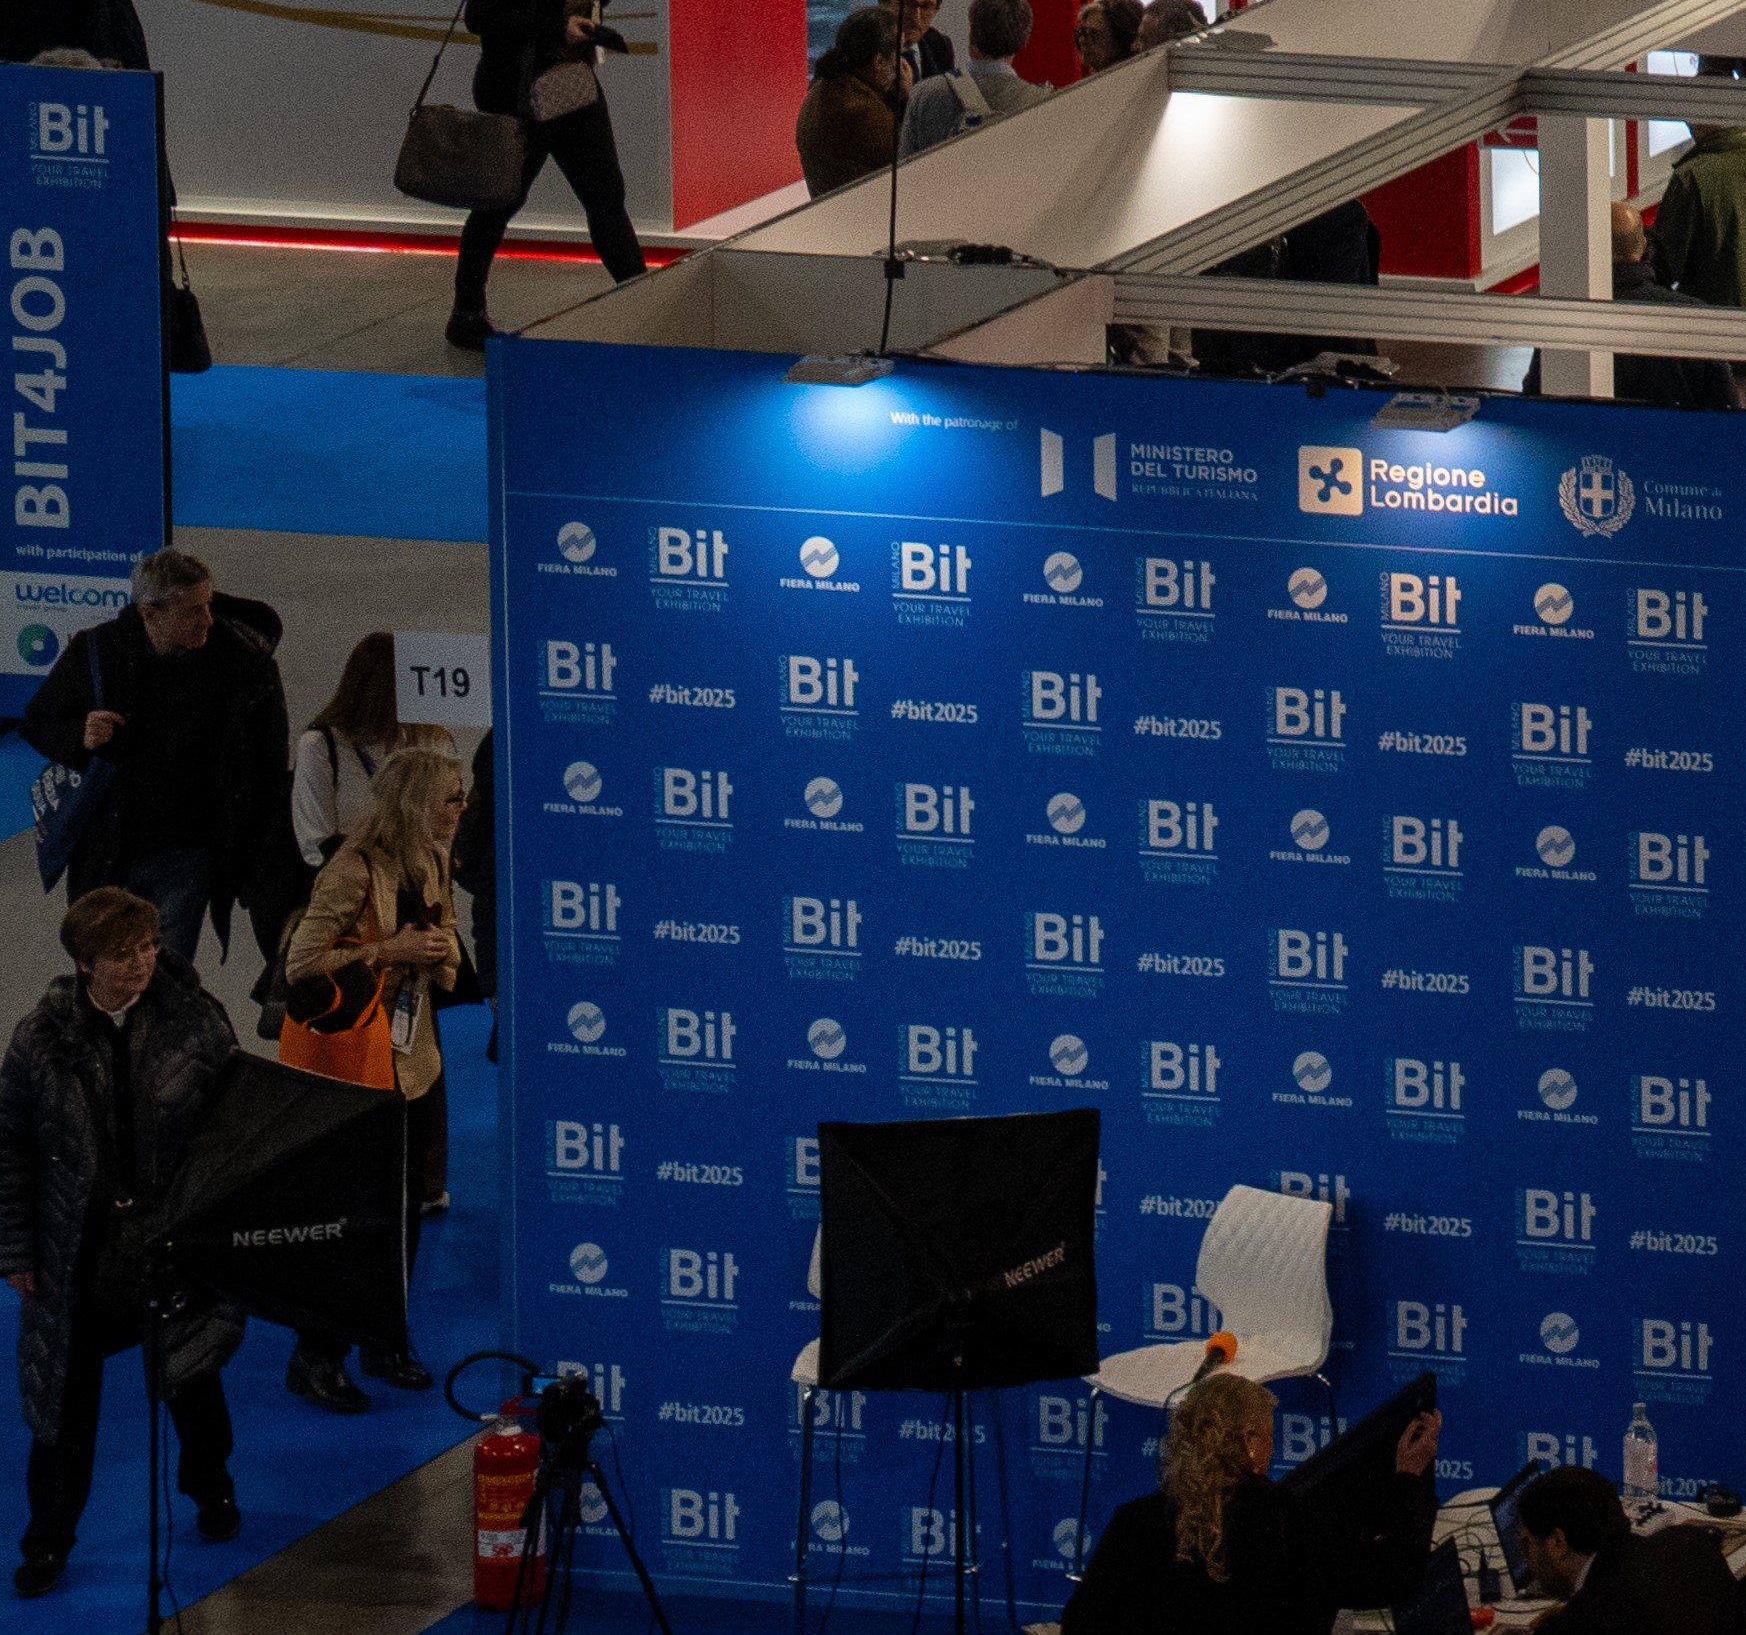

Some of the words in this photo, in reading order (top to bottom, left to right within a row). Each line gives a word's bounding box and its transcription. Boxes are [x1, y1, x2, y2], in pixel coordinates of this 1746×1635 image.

[39, 102, 110, 155] Bit
[11, 225, 70, 530] BIT4JOB
[891, 411, 920, 427] With
[923, 413, 941, 427] the
[943, 415, 1004, 434] patronage
[1006, 418, 1019, 431] of
[1131, 443, 1234, 465] MINISTERO
[1131, 461, 1167, 478] DEL
[1172, 463, 1258, 485] TURISMO
[1370, 458, 1486, 491] Regione
[1370, 484, 1518, 516] Lombardia
[1644, 481, 1708, 497] Comune
[1644, 497, 1723, 521] Milano
[16, 544, 44, 557] with
[46, 548, 127, 564] participation
[901, 541, 972, 593] Bit
[15, 582, 131, 607] welcom
[780, 577, 813, 590] FIERA
[815, 579, 861, 593] MILANO
[893, 601, 926, 614] YOUR
[929, 604, 972, 617] TRAVEL
[1390, 573, 1461, 624] Bit
[897, 612, 965, 627] EXHIBITION
[409, 665, 471, 697] T19
[891, 699, 977, 724] #bit2025
[1378, 731, 1467, 756] #bit2025
[232, 1222, 343, 1248] NEEWER
[1629, 1230, 1718, 1256] #bit2025
[1004, 1247, 1064, 1288] NEEWER
